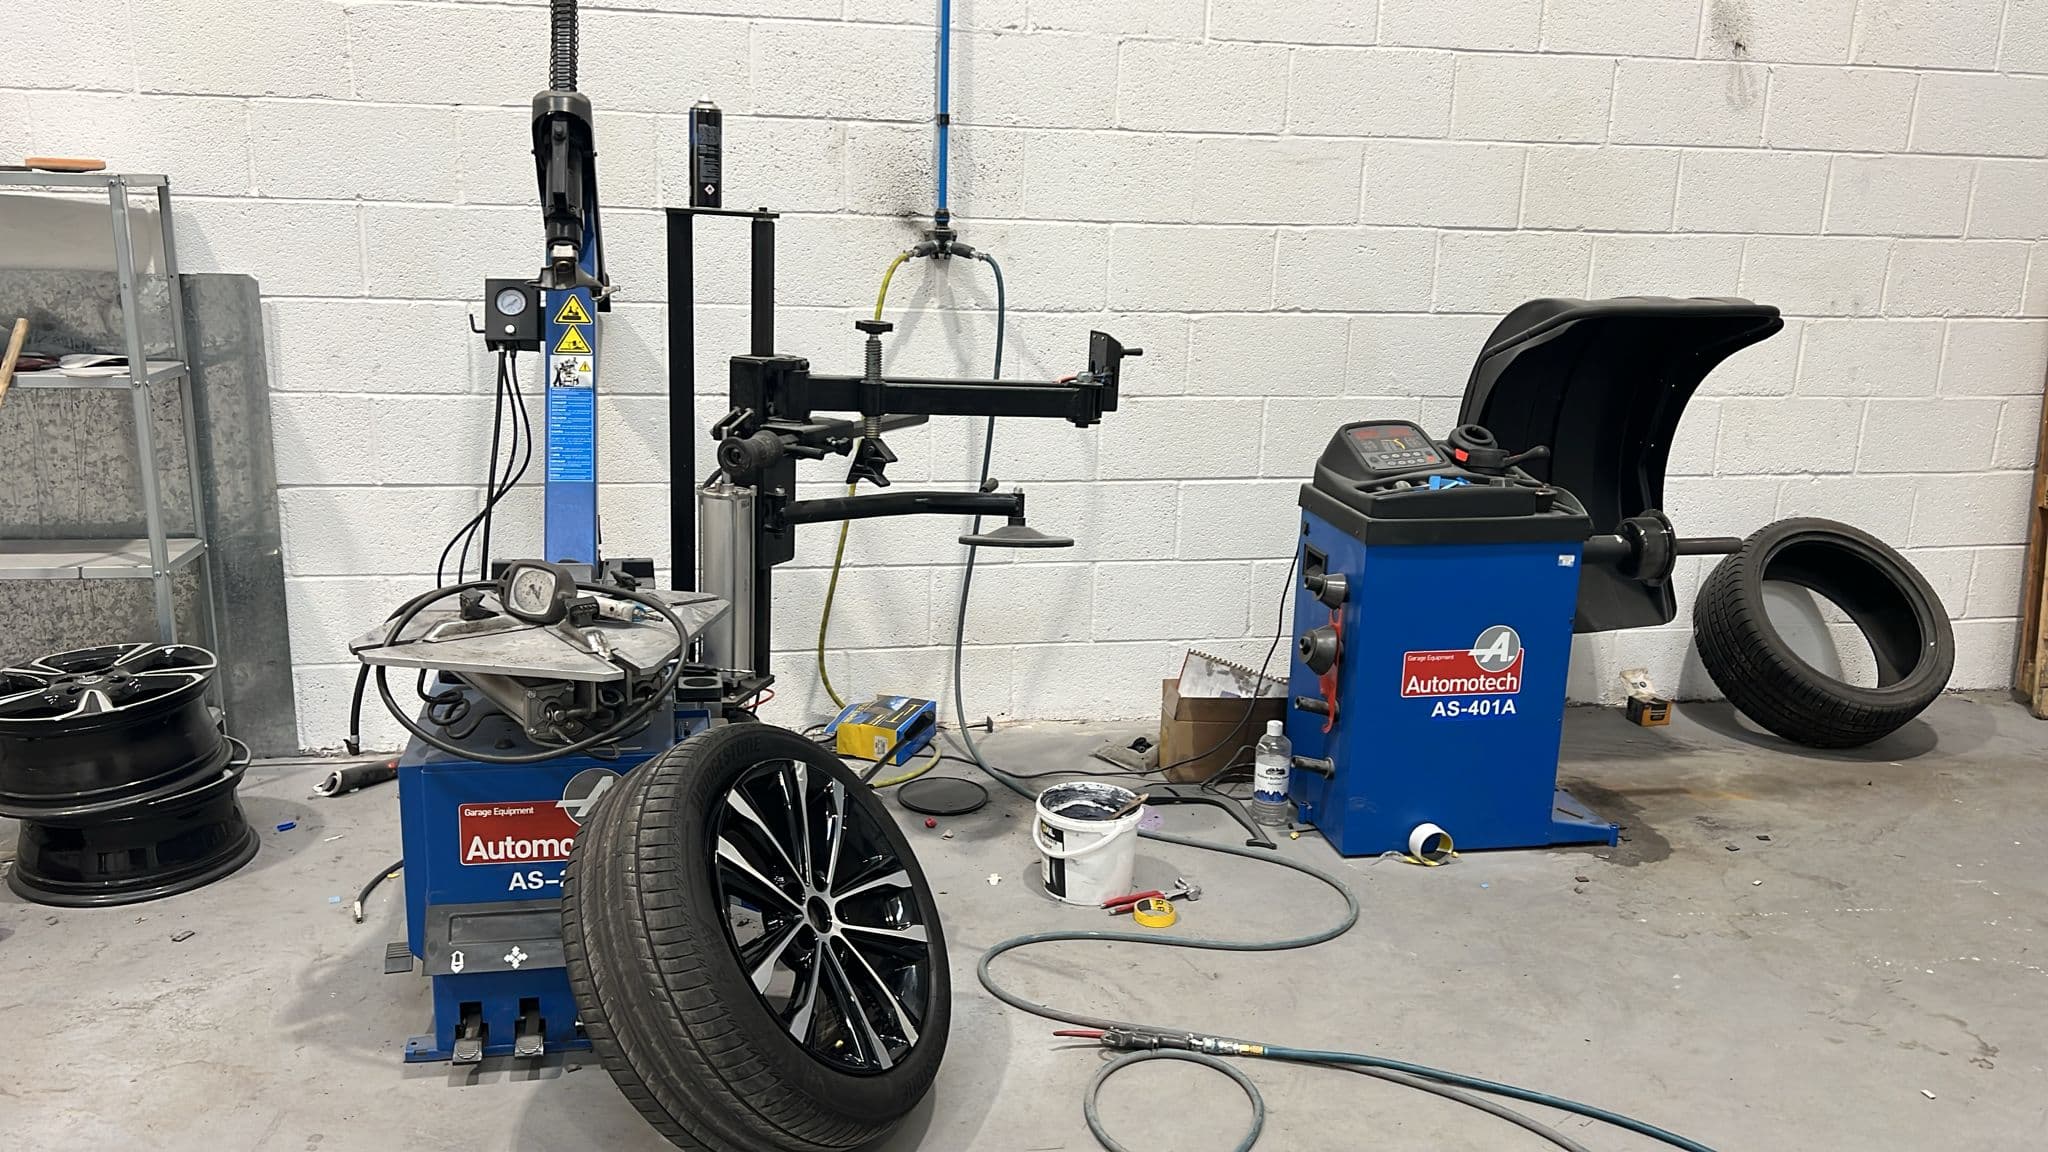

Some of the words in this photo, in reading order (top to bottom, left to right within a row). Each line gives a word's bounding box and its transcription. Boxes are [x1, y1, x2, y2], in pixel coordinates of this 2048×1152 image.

[1405, 672, 1518, 694] Automotech
[1431, 699, 1516, 718] AS-401A
[464, 808, 492, 818] Garage
[493, 806, 534, 816] Equipment
